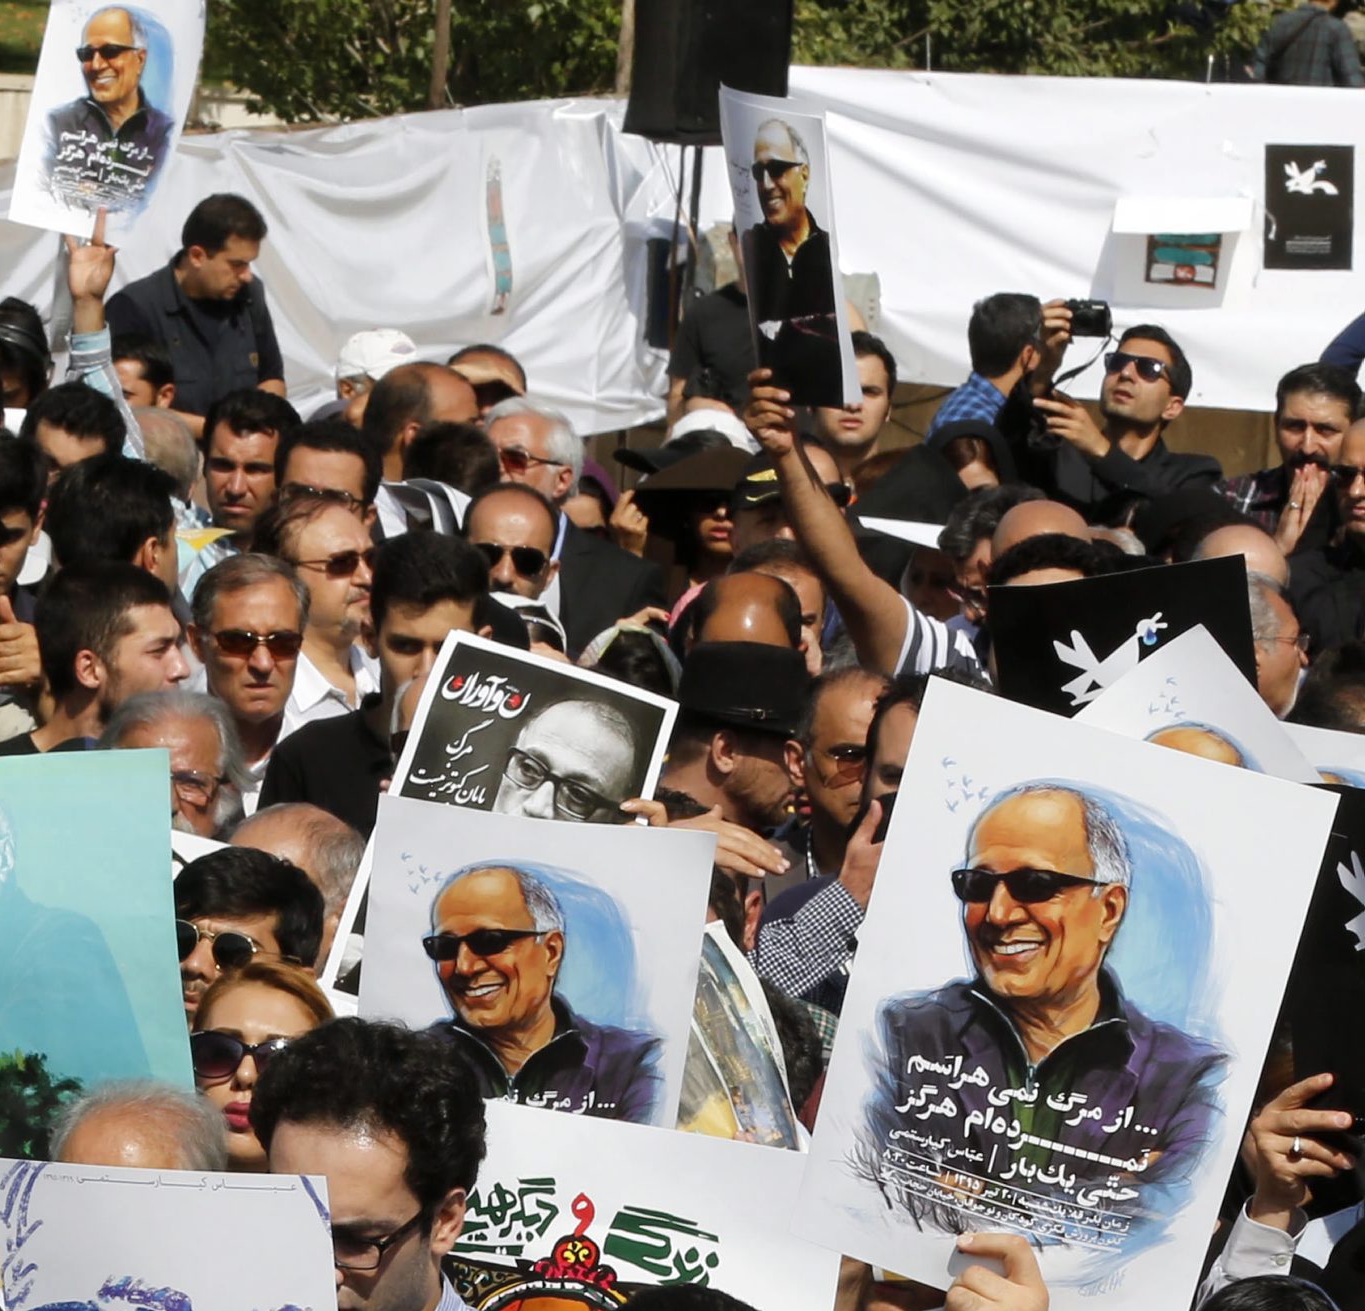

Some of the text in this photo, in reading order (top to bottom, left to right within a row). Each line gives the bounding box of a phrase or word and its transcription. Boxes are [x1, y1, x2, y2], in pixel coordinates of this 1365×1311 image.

[573, 1091, 596, 1114] از
[894, 1084, 957, 1120] هرگز
[1046, 1092, 1102, 1126] مرگ
[1102, 1106, 1135, 1133] از
[889, 1127, 951, 1150] کیارستمی
[906, 1160, 941, 1177] ساعت
[76, 1174, 297, 1191] عباس کیارستمی
[953, 1173, 982, 1190] ۱۳۹۵
[981, 1185, 1000, 1198] تیر
[571, 1192, 595, 1237] و
[1000, 1211, 1038, 1230] کودکان
[1103, 1218, 1130, 1234] زمان
